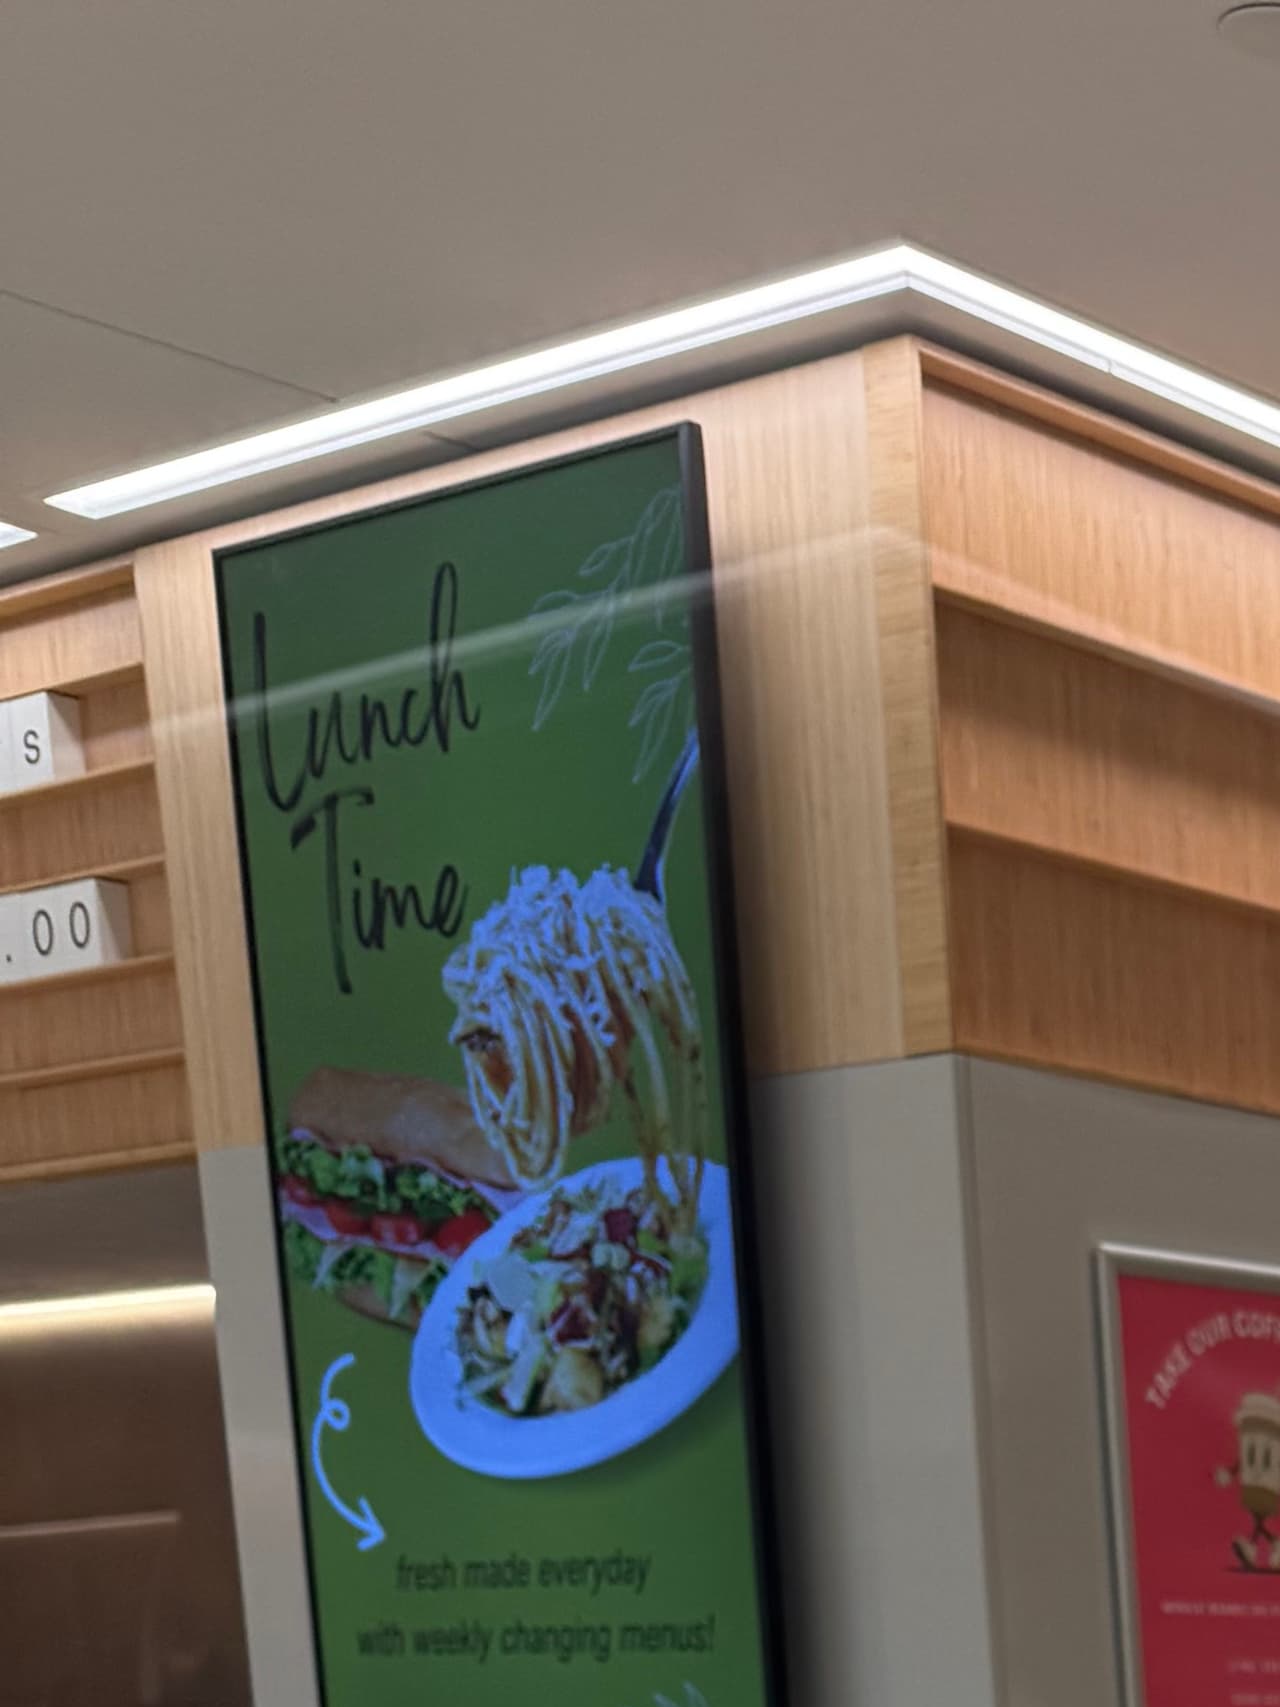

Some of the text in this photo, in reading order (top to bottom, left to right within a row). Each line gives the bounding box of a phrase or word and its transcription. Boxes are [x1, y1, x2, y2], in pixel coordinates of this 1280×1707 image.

[254, 561, 481, 812] Lunch
[290, 786, 469, 994] Time
[395, 1549, 653, 1595] fresh made everyday
[356, 1614, 716, 1663] with weekly changing menus!
